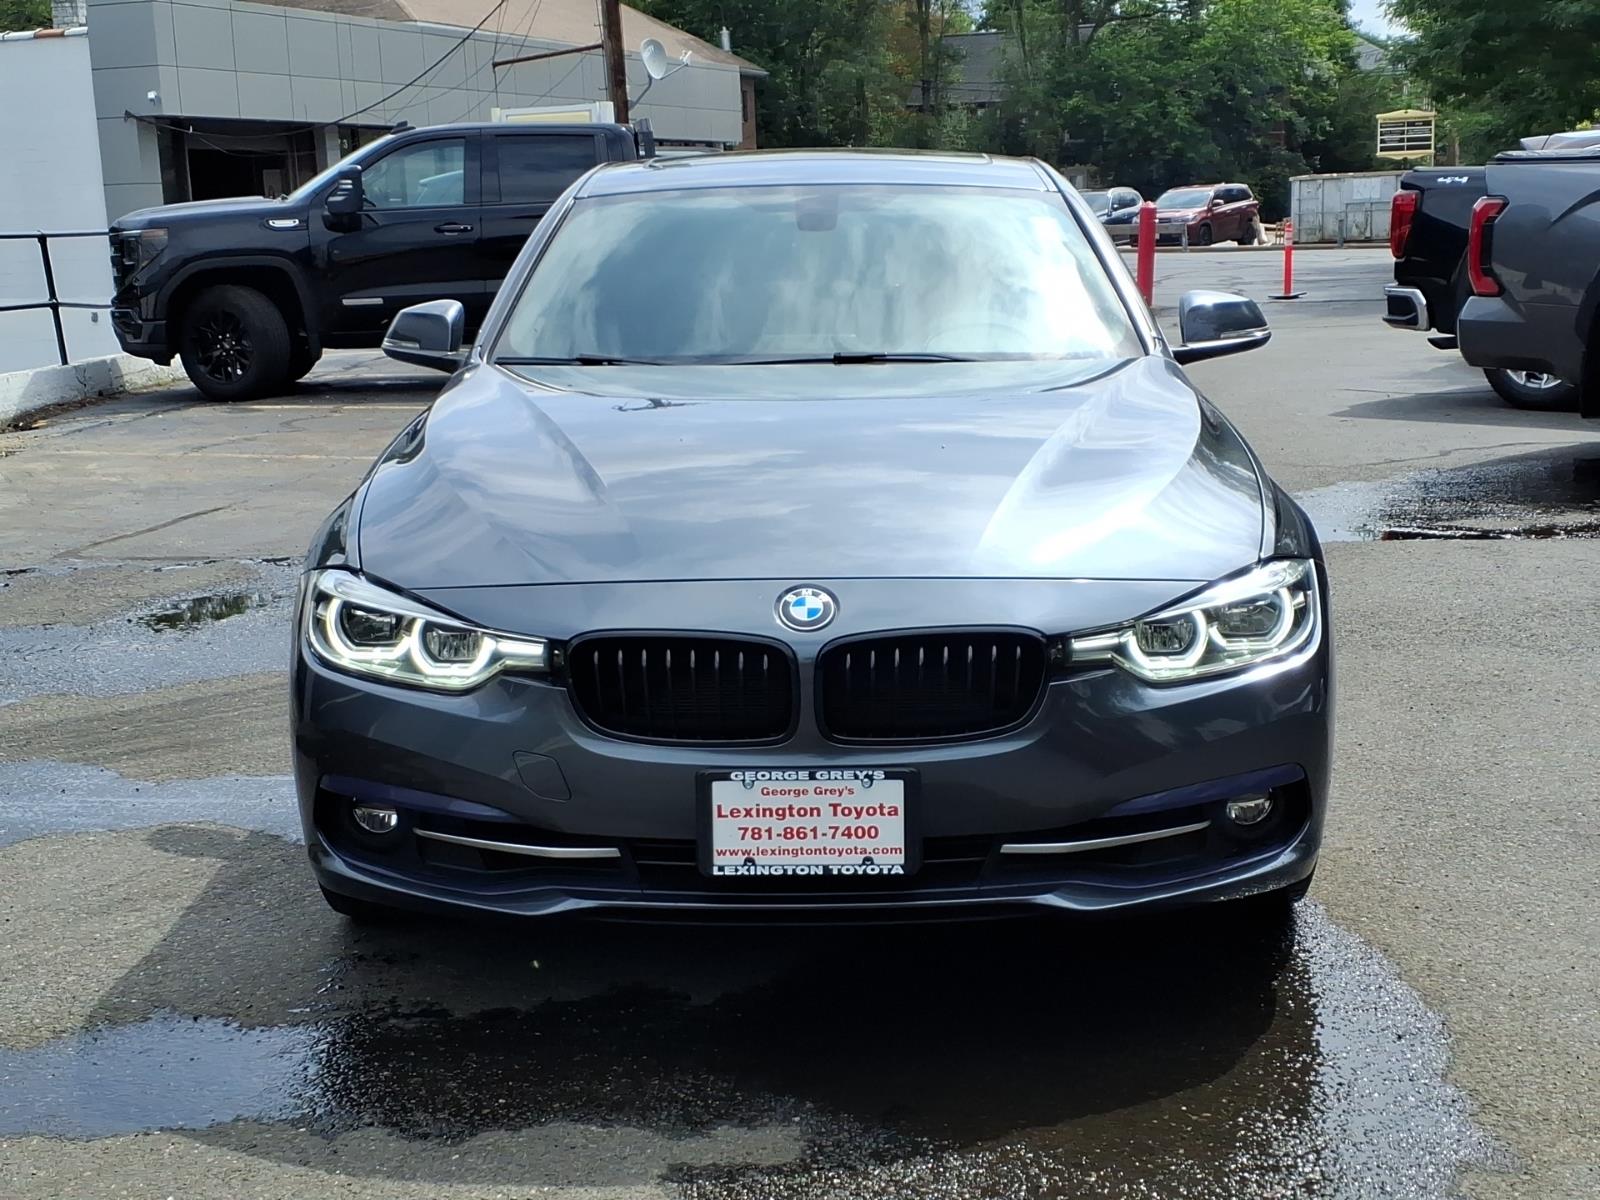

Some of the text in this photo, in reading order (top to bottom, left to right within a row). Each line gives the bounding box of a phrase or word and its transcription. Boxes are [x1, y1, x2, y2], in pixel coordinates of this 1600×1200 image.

[730, 770, 886, 781] GEORGE GREY'S
[760, 786, 855, 798] George Grey's
[716, 803, 899, 821] Lexington Toyota
[737, 825, 880, 841] 781-861-7400
[715, 845, 903, 858] www.lexingtontoyota.com
[712, 864, 905, 876] LEXINGTON TOYOTA
